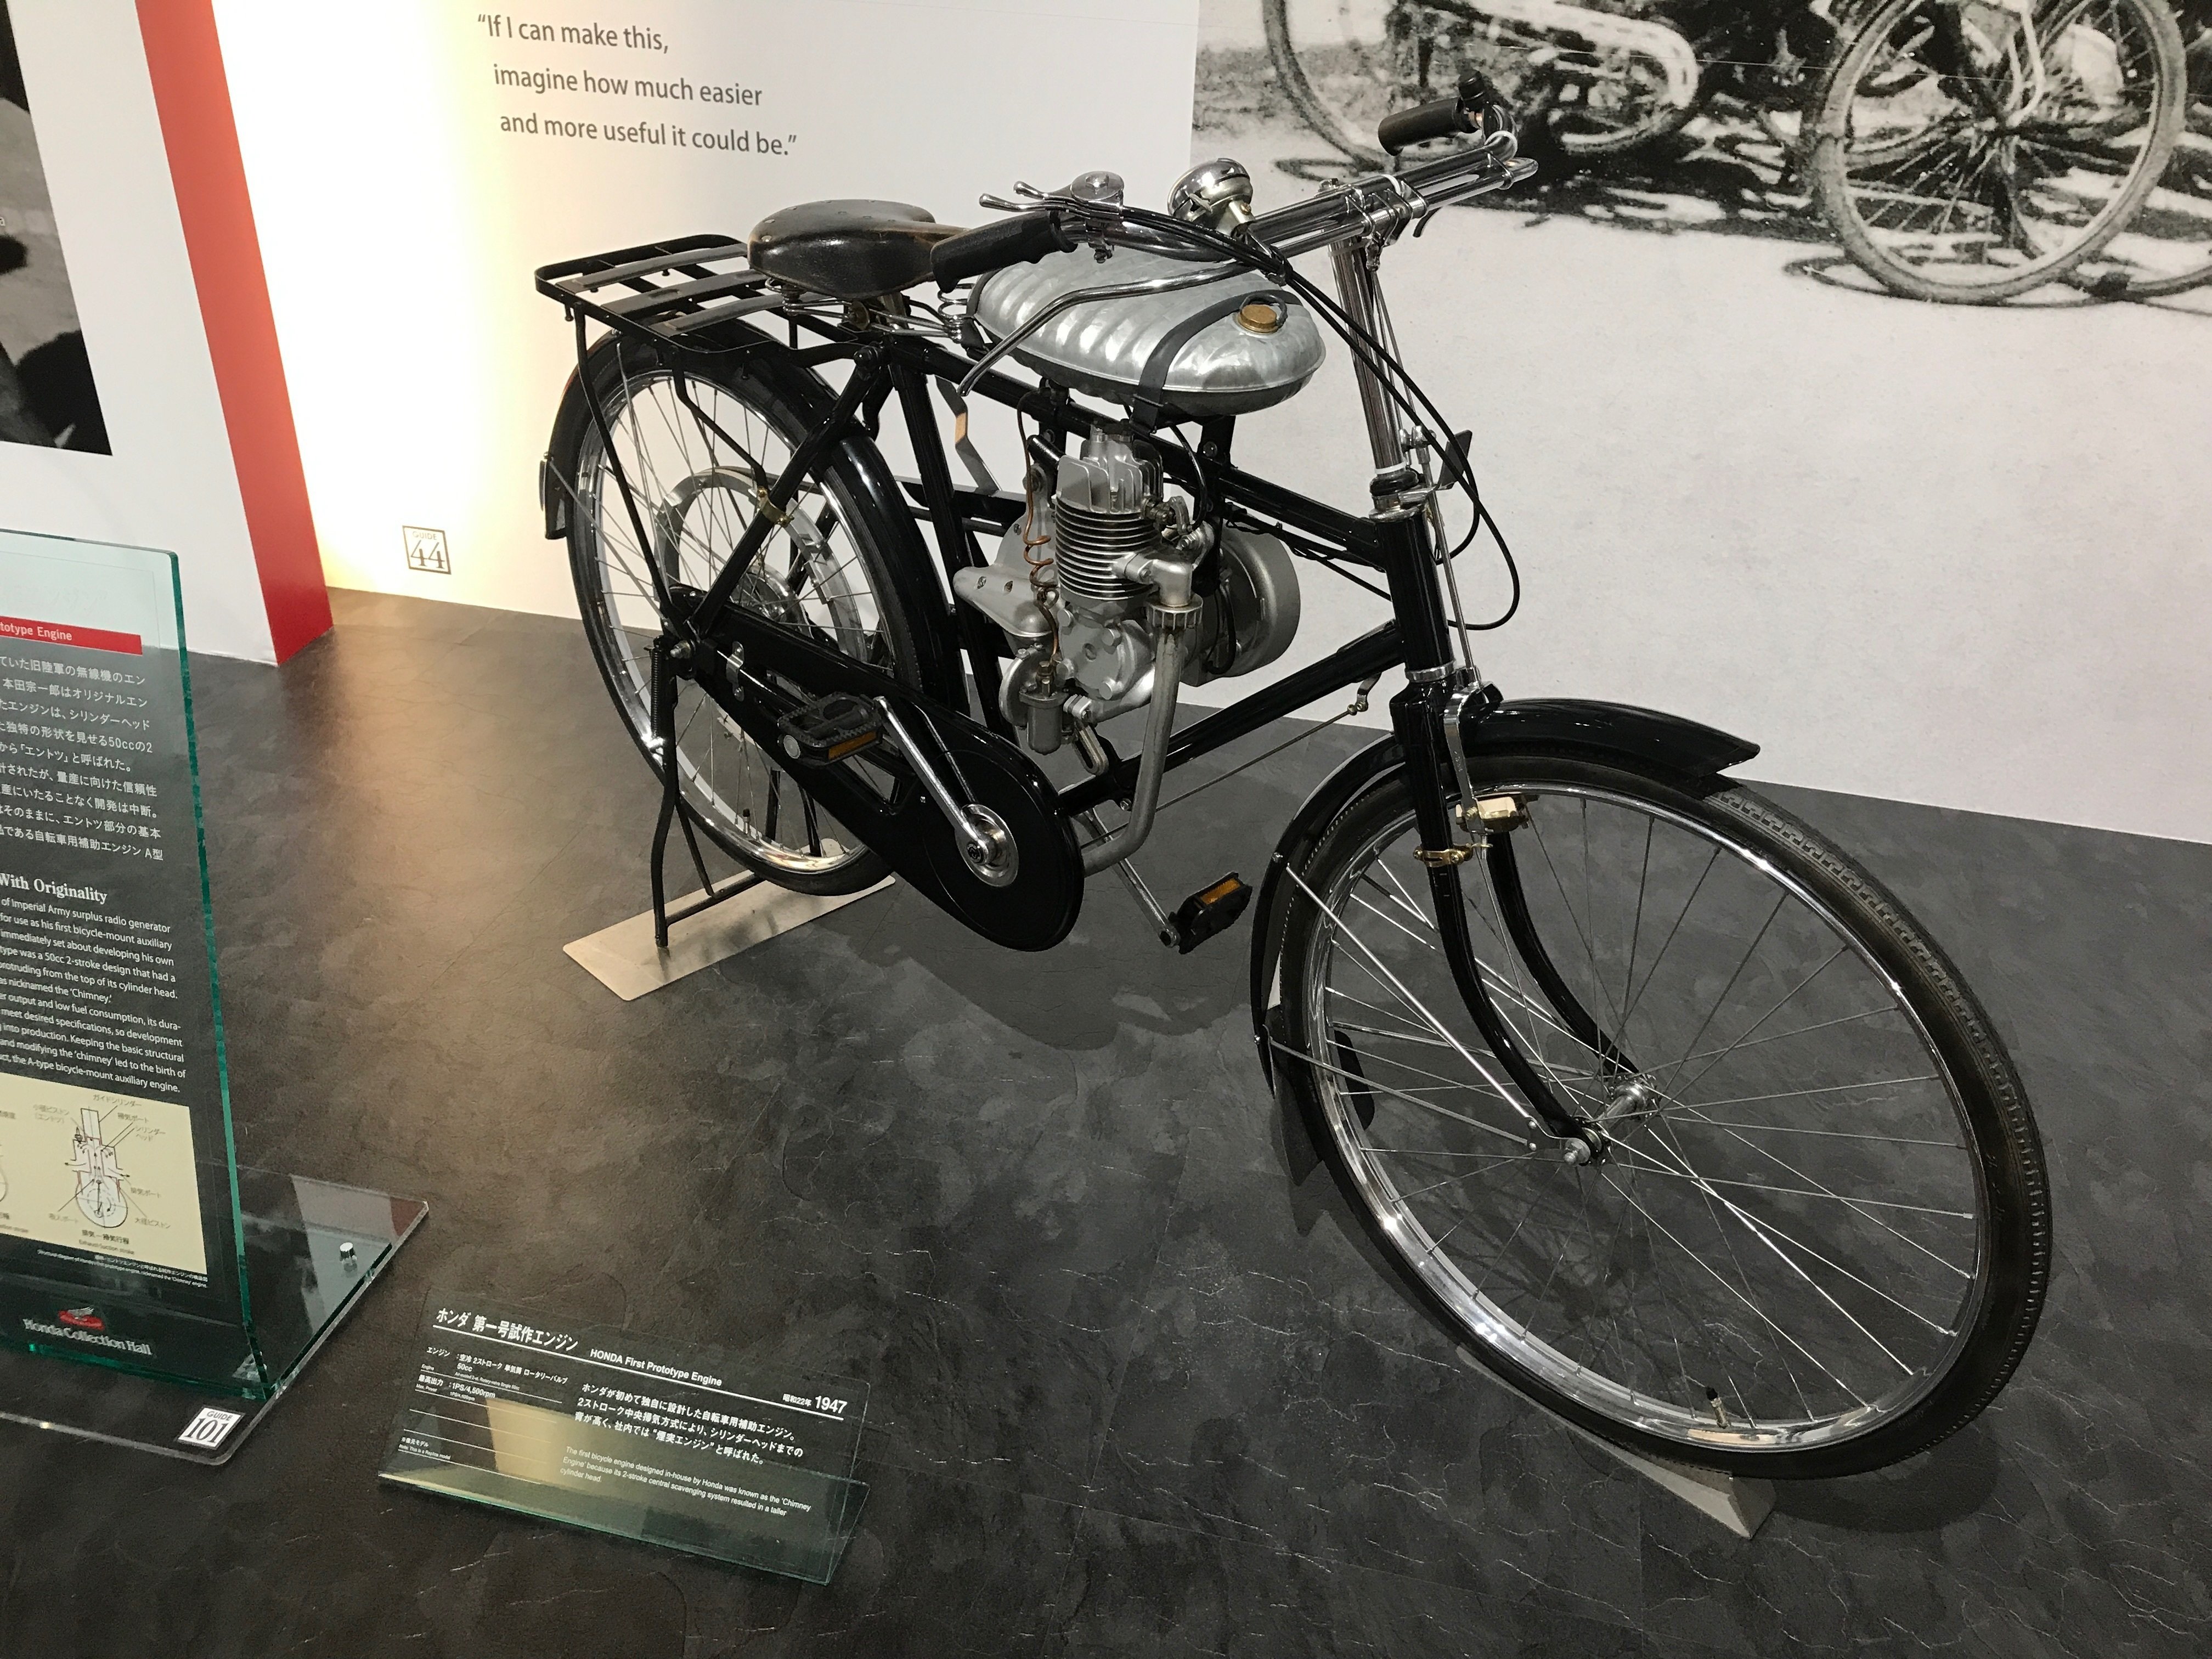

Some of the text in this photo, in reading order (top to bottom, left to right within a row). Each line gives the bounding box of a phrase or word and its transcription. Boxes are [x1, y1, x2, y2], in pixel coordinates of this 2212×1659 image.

[507, 16, 512, 38] I
[518, 23, 555, 41] can
[561, 22, 618, 46] make
[623, 25, 668, 54] this,
[494, 64, 762, 105] imagine how much easier
[500, 112, 797, 156] and more useful it could be.”
[413, 531, 437, 540] GUIDE
[410, 540, 445, 569] 44
[37, 626, 72, 641] Engine
[2, 678, 147, 707] 本田宗一郎はオリジナルエン
[145, 848, 163, 861] A型
[0, 873, 108, 905] With Originality
[0, 912, 12, 923] for
[14, 917, 29, 926] use
[41, 919, 54, 930] his
[55, 921, 71, 933] first
[73, 924, 135, 944] bicycle-mount
[137, 937, 172, 952] auxiliary
[1, 898, 171, 933] of Imperial Army surplus radio generator
[20, 950, 36, 958] was
[45, 952, 65, 963] 50cc
[66, 956, 100, 969] 2-stroke
[102, 962, 131, 975] design
[133, 967, 150, 978] that
[152, 970, 168, 981] had
[53, 939, 65, 948] set
[67, 940, 92, 952] about
[93, 945, 139, 962] developing
[142, 952, 154, 963] his
[155, 957, 174, 966] own
[43, 967, 63, 979] from
[64, 972, 78, 981] the
[80, 975, 95, 985] top
[97, 978, 105, 986] of
[107, 979, 117, 988] its
[119, 982, 152, 994] cylinder
[154, 986, 178, 998] head.
[55, 985, 69, 996] the
[1, 1009, 22, 1018] meet
[24, 1011, 54, 1024] desired
[55, 1018, 114, 1036] specifications,
[126, 1029, 183, 1047] development
[8, 994, 36, 1005] output
[37, 1000, 54, 1008] and
[55, 1001, 70, 1011] low
[71, 1003, 87, 1014] fuel
[89, 1009, 146, 1025] consumption,
[147, 1017, 156, 1026] its
[159, 1019, 181, 1030] dura-
[16, 1042, 58, 1057] modifying
[59, 1048, 73, 1058] the
[115, 1057, 128, 1068] led
[129, 1061, 139, 1070] to
[140, 1062, 154, 1073] the
[155, 1065, 176, 1076] birth
[177, 1069, 187, 1078] of
[21, 1028, 69, 1042] production.
[70, 1034, 104, 1050] Keeping
[106, 1041, 120, 1051] the
[121, 1043, 144, 1055] basic
[145, 1049, 184, 1063] structural
[12, 1054, 27, 1064] the
[27, 1057, 54, 1070] A-type
[55, 1062, 114, 1081] bicycle-mount
[115, 1074, 148, 1088] auxiliary
[149, 1081, 180, 1093] engine.
[22, 1319, 153, 1355] Honda Collection Hall
[436, 1307, 578, 1351] ホンダ 第一号試作エンジン
[426, 1346, 450, 1357] エンジン
[473, 1357, 503, 1369] 2ストローク
[523, 1369, 568, 1384] ロータリーバルブ
[590, 1348, 722, 1386] HONDA First Prototype Engine
[207, 1410, 233, 1421] GUIDE
[582, 1383, 794, 1441] ホンダが初めて独自に設計した自転車用補助エンジン。
[782, 1393, 848, 1414] 昭和22年 1947
[184, 1418, 229, 1443] 101
[560, 1467, 602, 1482] cylinder head.
[566, 1446, 578, 1455] The
[579, 1449, 590, 1458] first
[591, 1452, 612, 1463] bicycle
[613, 1458, 634, 1469] engine
[635, 1463, 664, 1476] designed
[664, 1469, 692, 1482] in-house
[692, 1477, 701, 1486] by
[702, 1479, 723, 1490] Honda
[724, 1485, 737, 1493] was
[738, 1487, 759, 1499] known
[769, 1495, 780, 1504] the
[586, 1462, 613, 1474] because
[622, 1470, 647, 1483] 2-stroke
[648, 1477, 670, 1488] central
[670, 1482, 706, 1498] scavenging
[707, 1492, 730, 1503] system
[731, 1497, 757, 1509] resulted
[757, 1503, 764, 1511] in
[770, 1506, 787, 1516] taller
